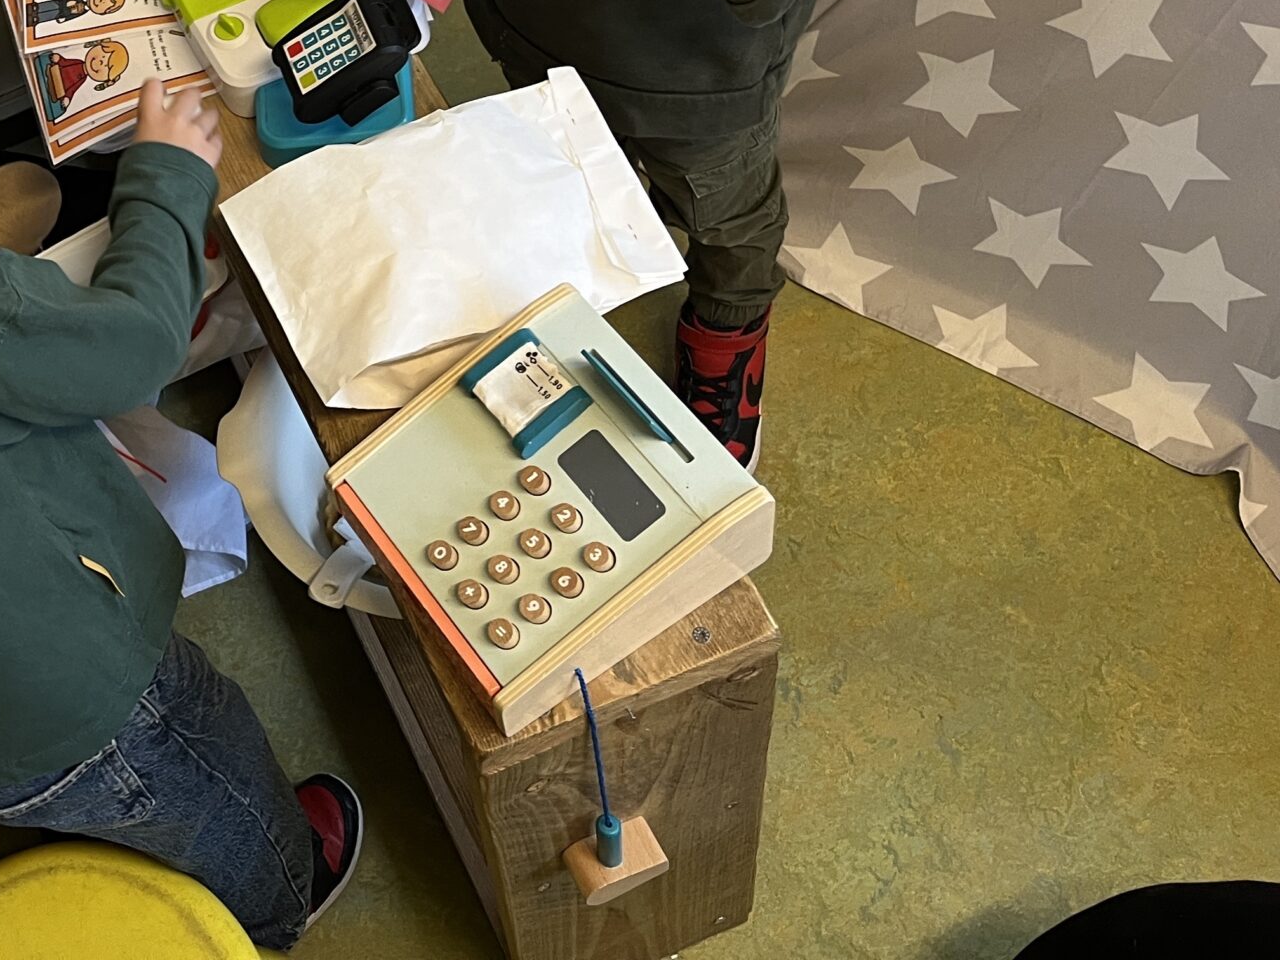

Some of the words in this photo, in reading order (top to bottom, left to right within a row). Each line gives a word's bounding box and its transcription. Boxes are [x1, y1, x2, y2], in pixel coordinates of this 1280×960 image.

[434, 546, 447, 560] 0
[497, 497, 510, 508] 4
[525, 535, 540, 548] 5
[558, 575, 572, 588] 6
[527, 472, 539, 483] 1
[556, 510, 571, 523] 2
[590, 548, 602, 562] 3
[462, 522, 477, 534] 7
[495, 560, 508, 574] 8
[526, 600, 540, 612] 9
